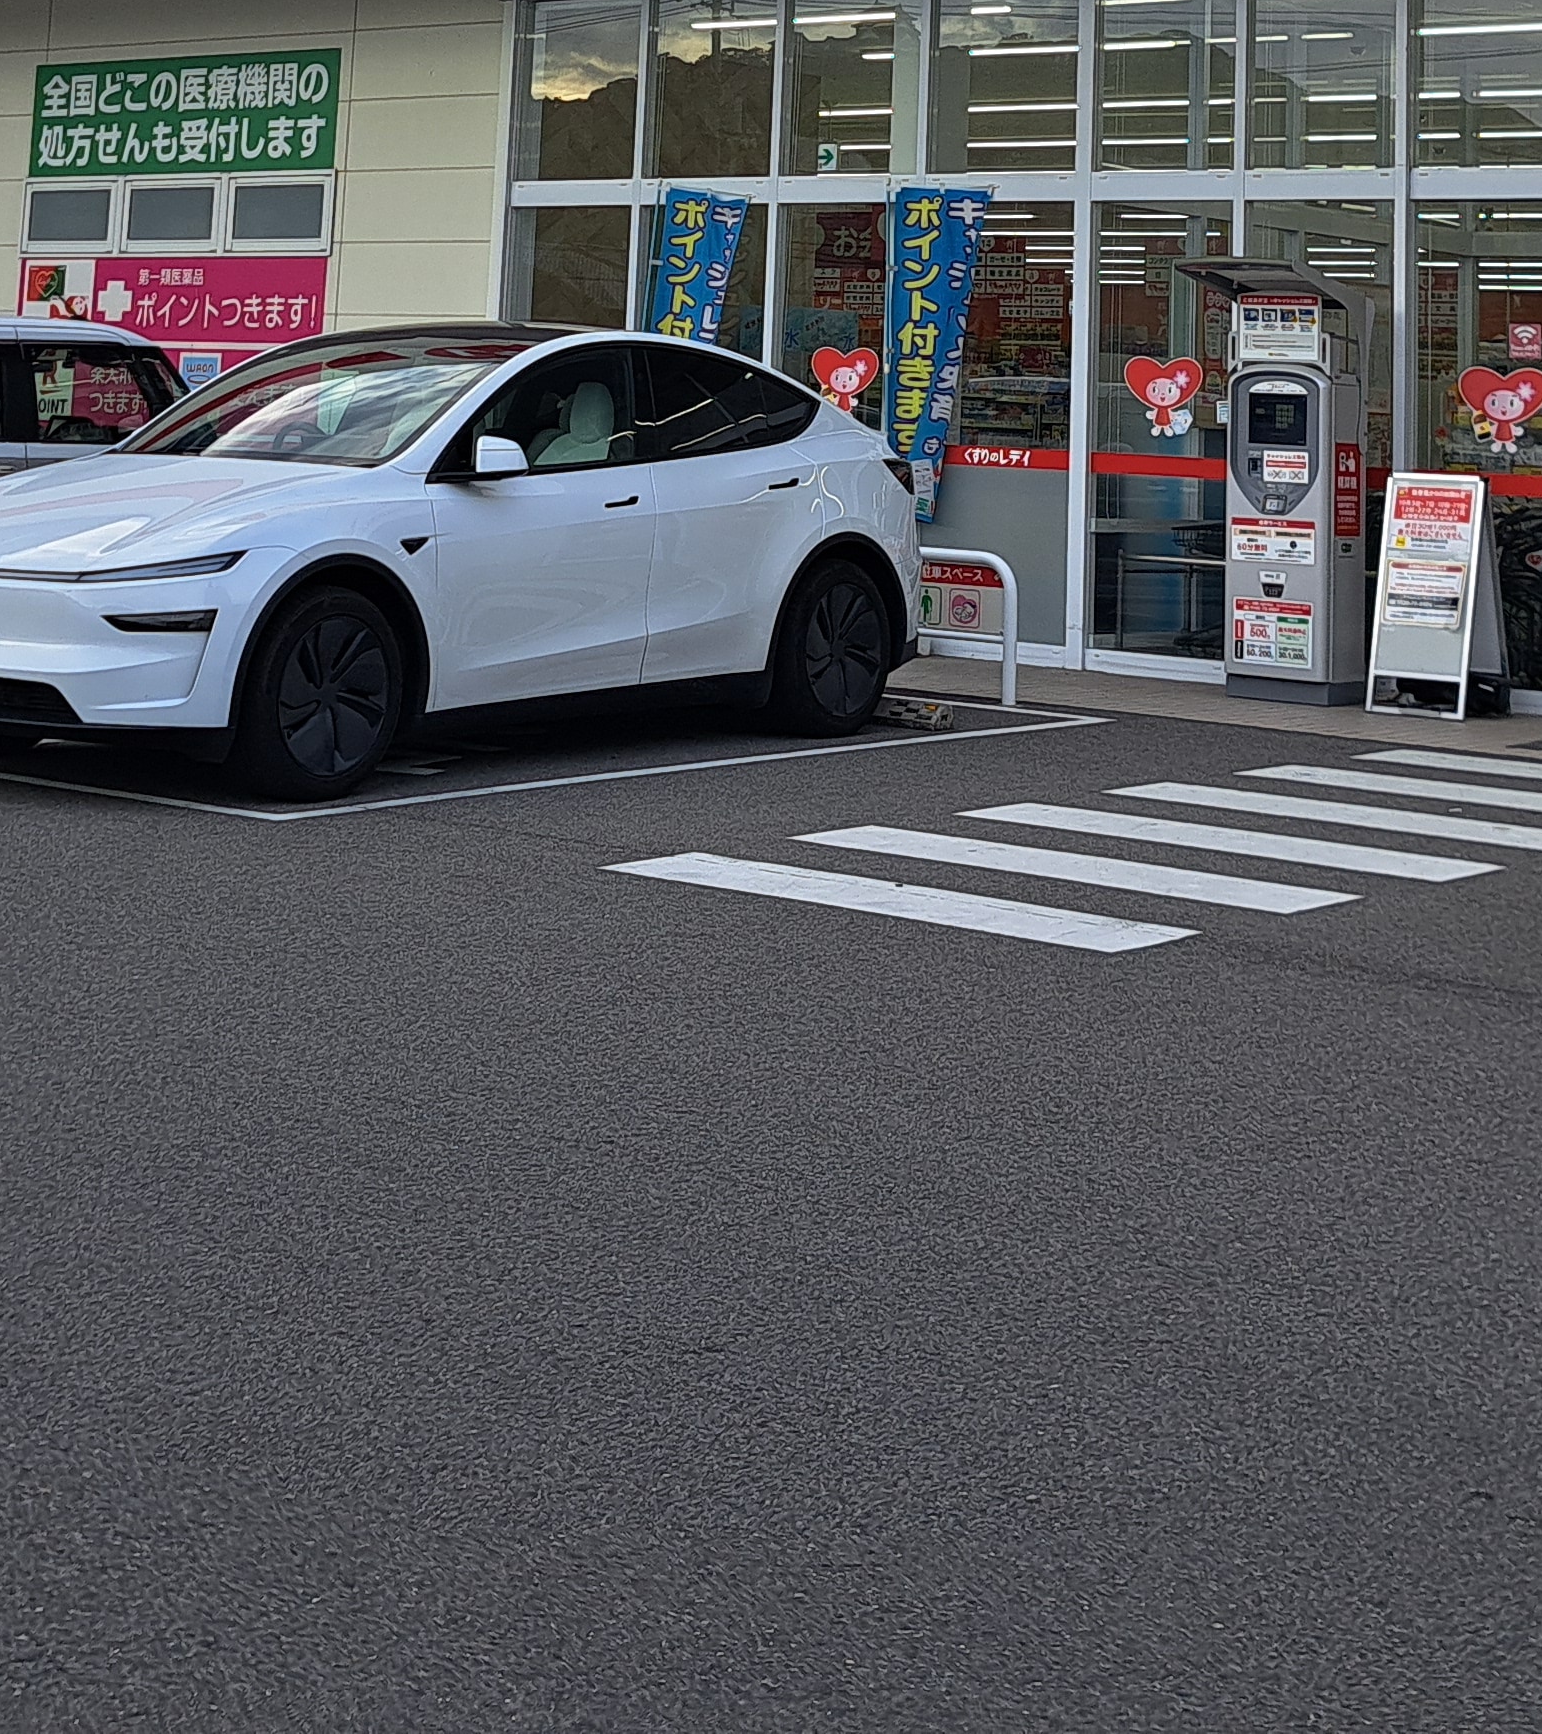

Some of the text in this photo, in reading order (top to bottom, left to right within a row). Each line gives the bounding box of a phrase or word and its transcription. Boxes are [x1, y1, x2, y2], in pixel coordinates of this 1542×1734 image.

[41, 61, 329, 120] 全国どこの医療機関の
[37, 112, 327, 171] 処方せんも受付します
[138, 267, 205, 287] 第一類医薬品
[135, 292, 318, 330] ポイントつきます!
[38, 398, 68, 414] OINT
